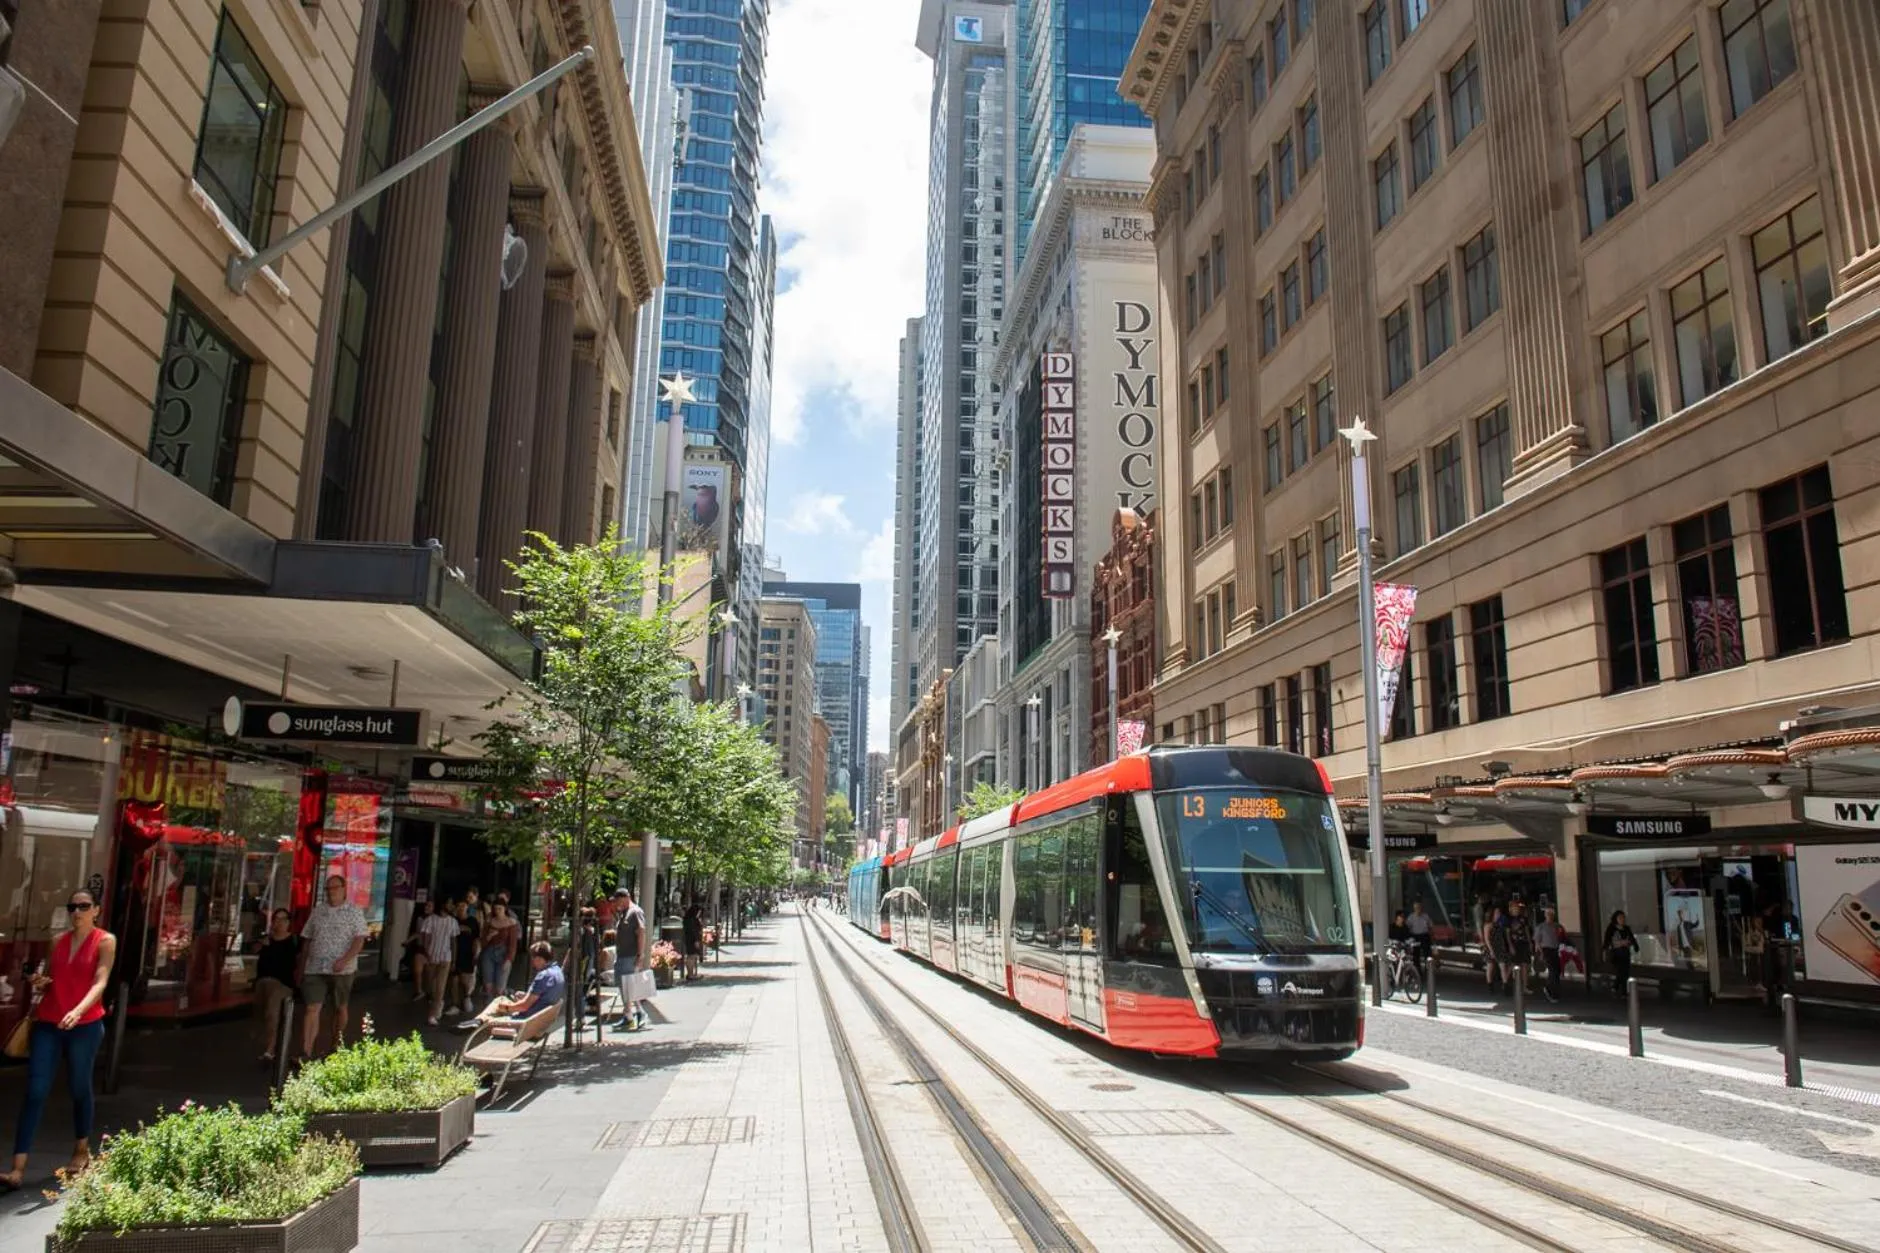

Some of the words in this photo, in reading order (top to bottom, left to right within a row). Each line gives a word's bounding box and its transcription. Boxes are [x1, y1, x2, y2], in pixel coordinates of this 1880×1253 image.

[1111, 216, 1142, 230] THE
[1050, 356, 1071, 560] DYMOCKS
[688, 469, 720, 477] SONY
[294, 715, 364, 736] sunglass
[365, 716, 394, 735] hut
[1183, 795, 1205, 817] L3
[1229, 797, 1279, 809] JUNIORS
[1222, 808, 1287, 819] KINGSFORD
[1616, 820, 1683, 834] SAMSUNG
[1326, 926, 1344, 942] 02
